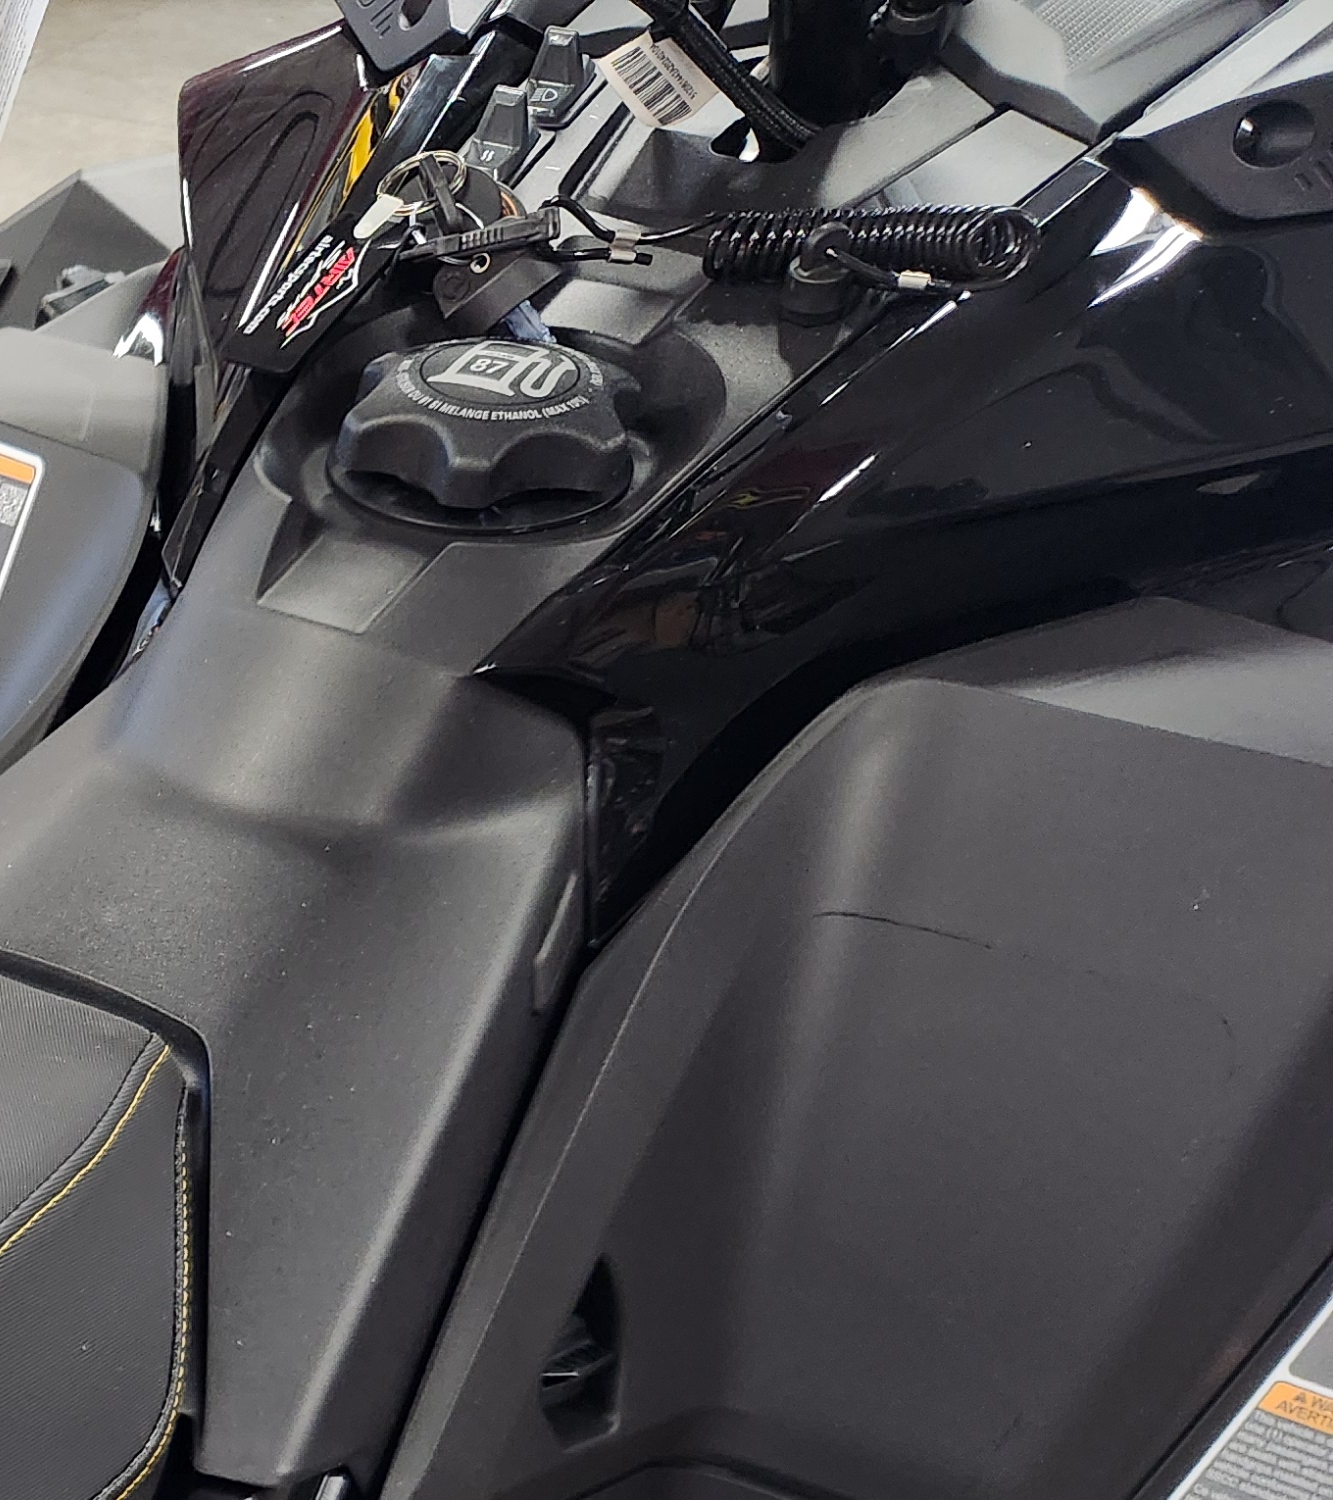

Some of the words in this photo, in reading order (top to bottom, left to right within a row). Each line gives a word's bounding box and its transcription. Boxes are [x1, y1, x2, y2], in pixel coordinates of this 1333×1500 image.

[242, 235, 334, 335] airtecsports.com
[281, 246, 355, 337] AIRTEC
[469, 357, 509, 375] 87
[438, 402, 490, 421] MELANGE
[490, 409, 542, 421] ETHANOL
